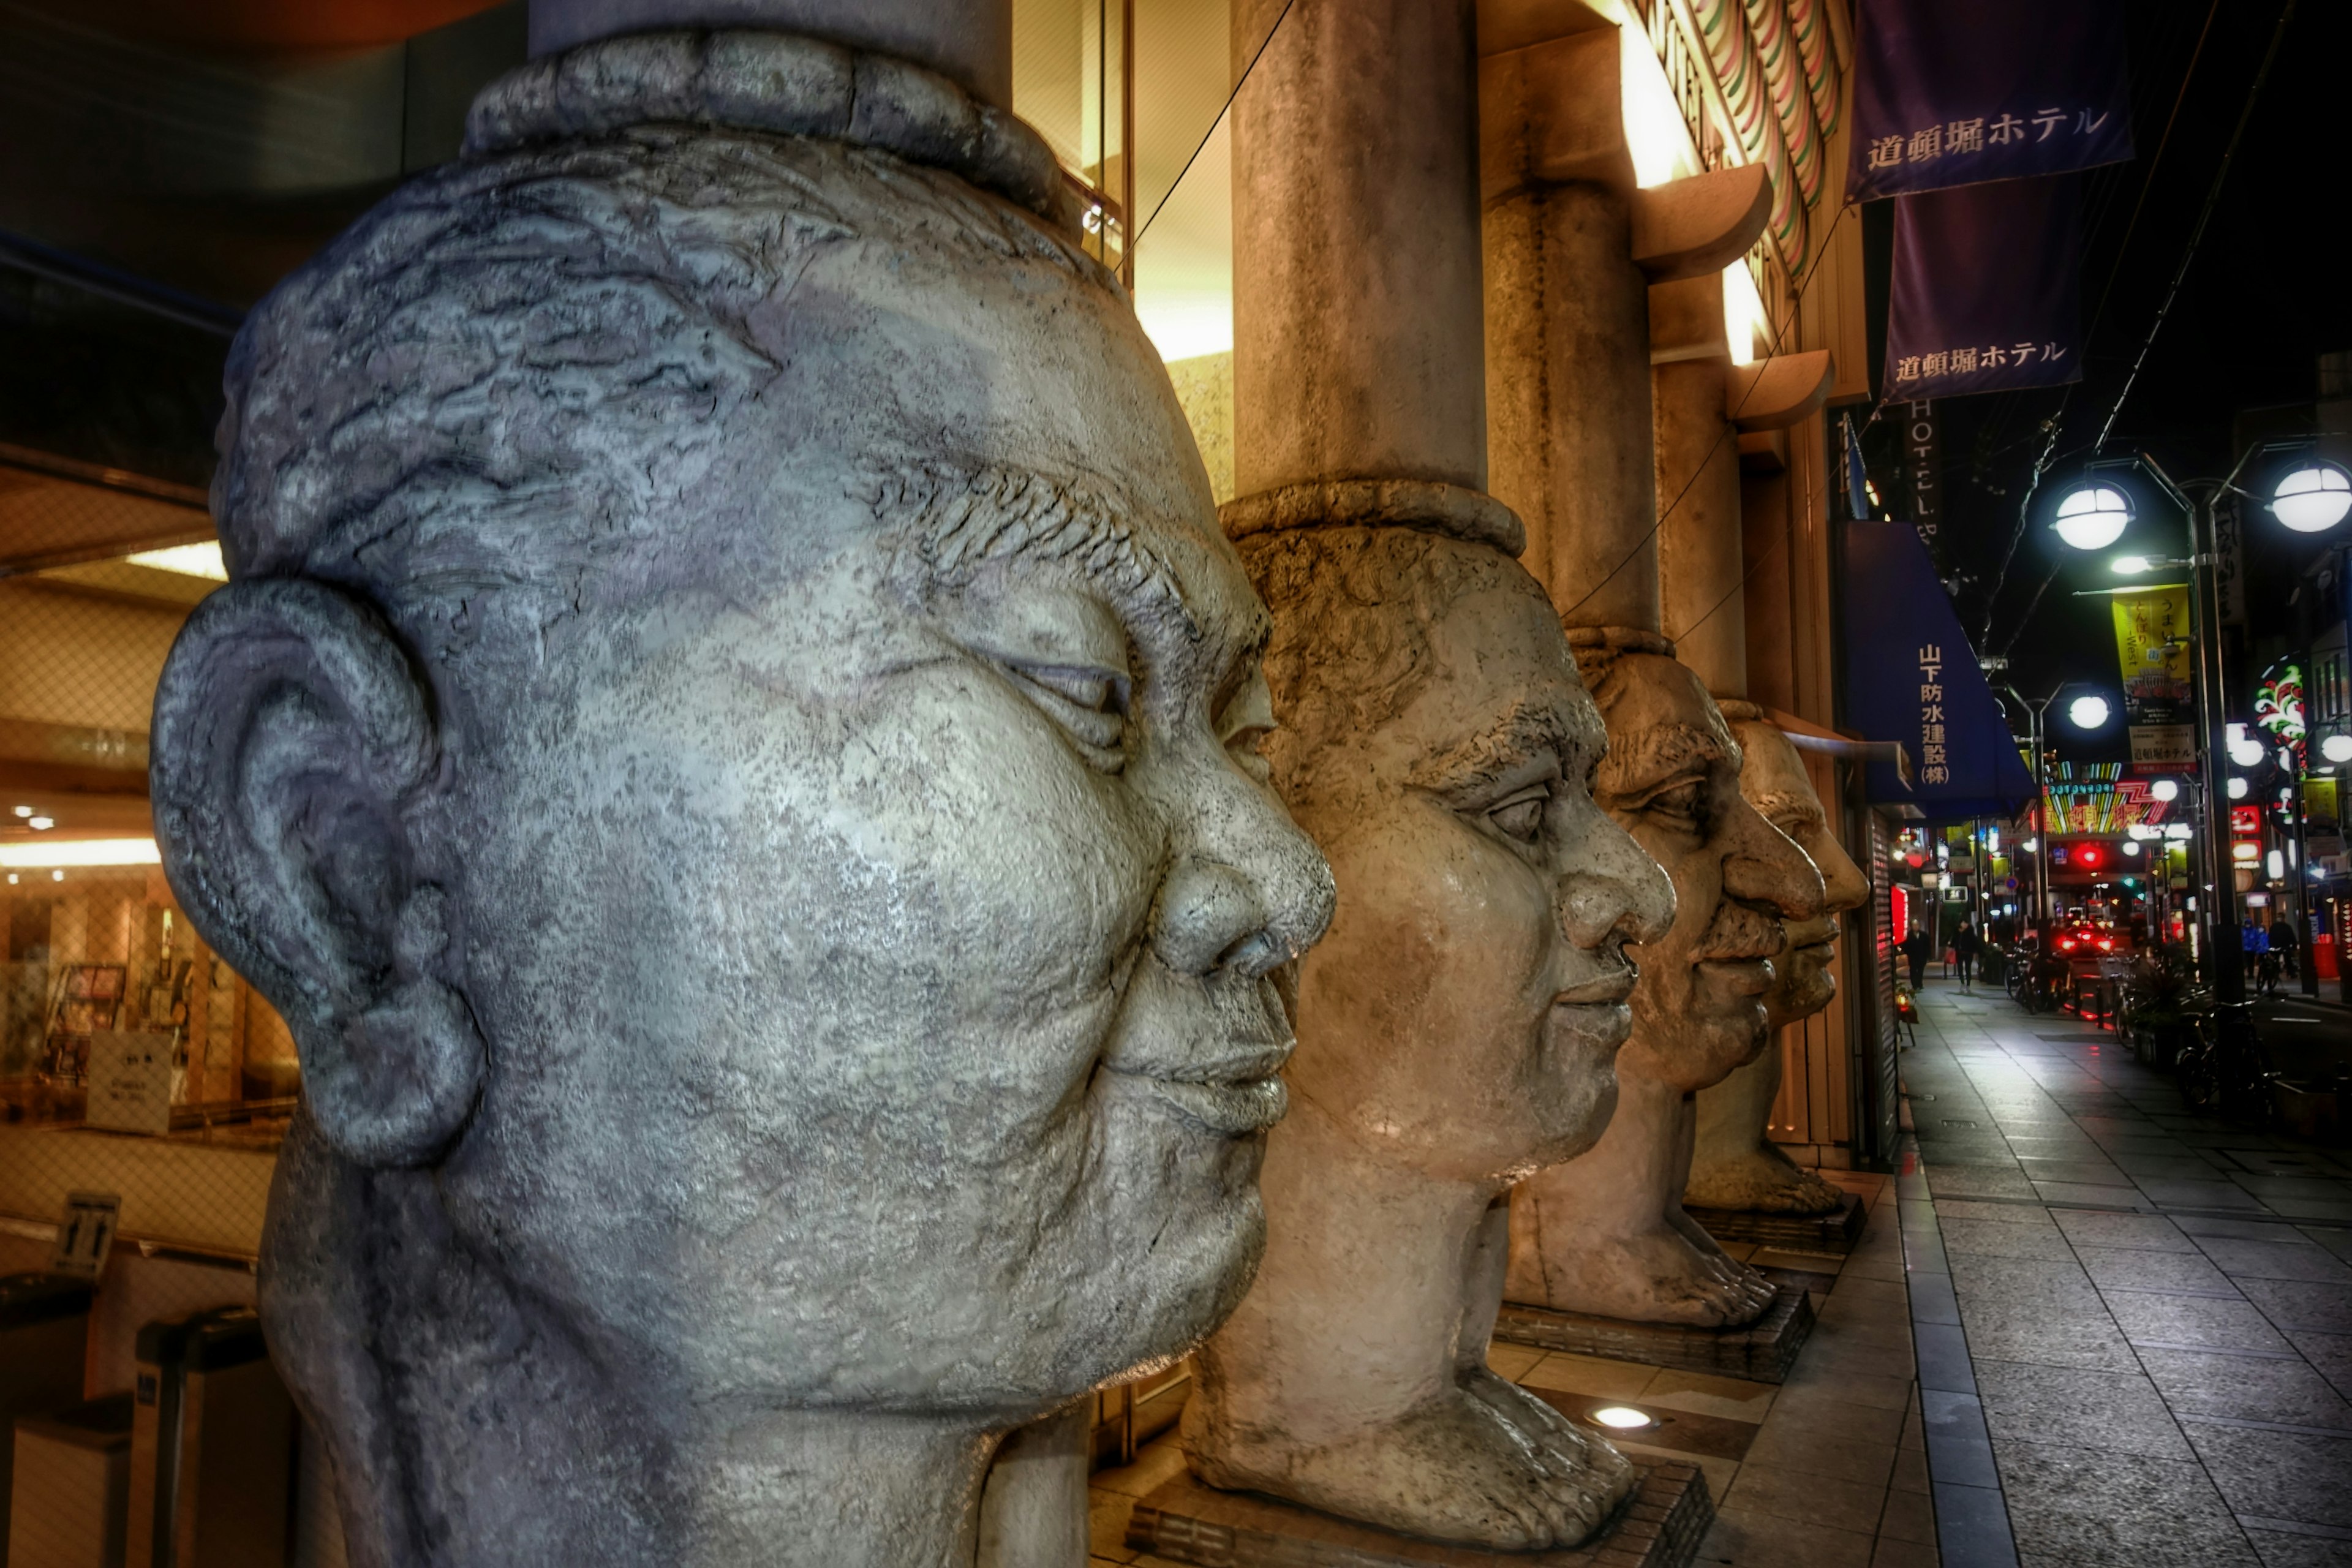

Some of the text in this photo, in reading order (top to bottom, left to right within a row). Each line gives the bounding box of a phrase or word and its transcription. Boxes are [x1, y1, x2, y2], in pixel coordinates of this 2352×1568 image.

[1868, 107, 2109, 172] 道頓堀ホテル
[1896, 341, 2068, 383] 道頓堀ホテル
